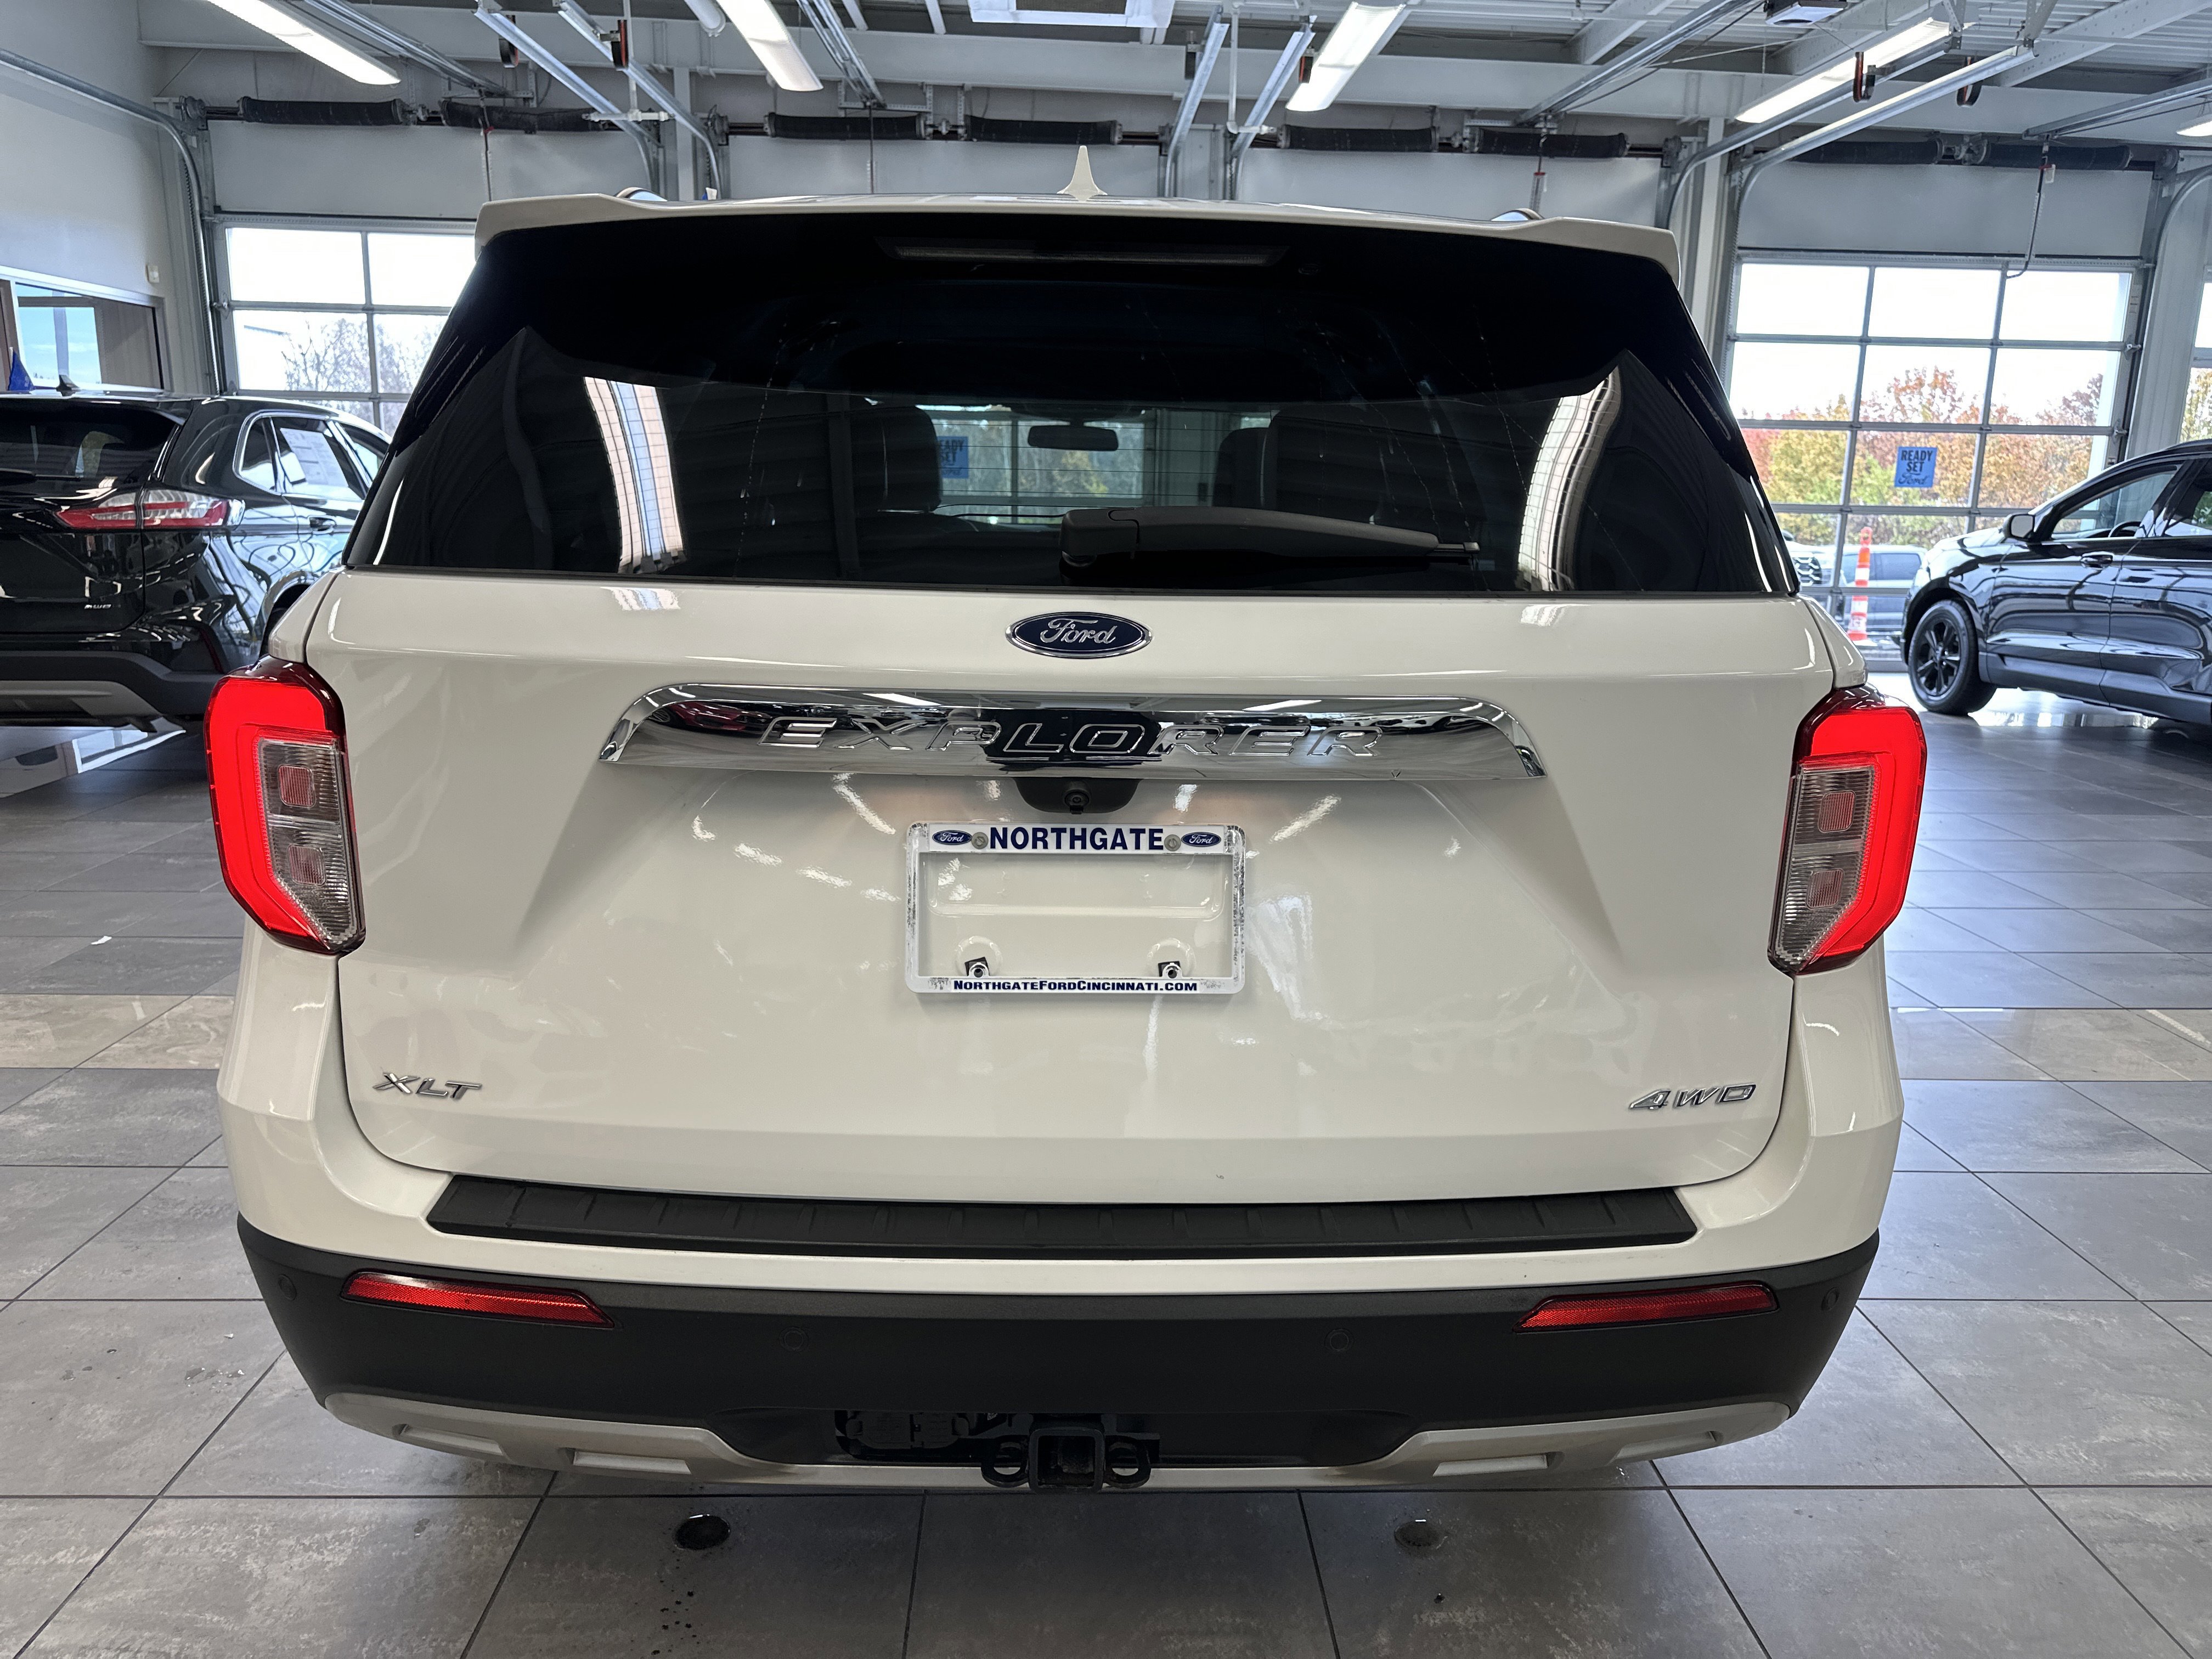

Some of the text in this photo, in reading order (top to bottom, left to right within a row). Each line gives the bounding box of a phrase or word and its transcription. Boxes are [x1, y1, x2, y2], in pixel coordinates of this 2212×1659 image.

[1901, 450, 1933, 461] READY
[1906, 461, 1925, 472] SET
[1898, 472, 1930, 485] Ford
[1040, 618, 1118, 644] Ford
[757, 716, 1384, 757] EXPLORER
[940, 827, 1214, 850] Ford NORTHGATE Ford
[373, 1072, 483, 1100] XLT
[1628, 1082, 1757, 1110] 4WD
